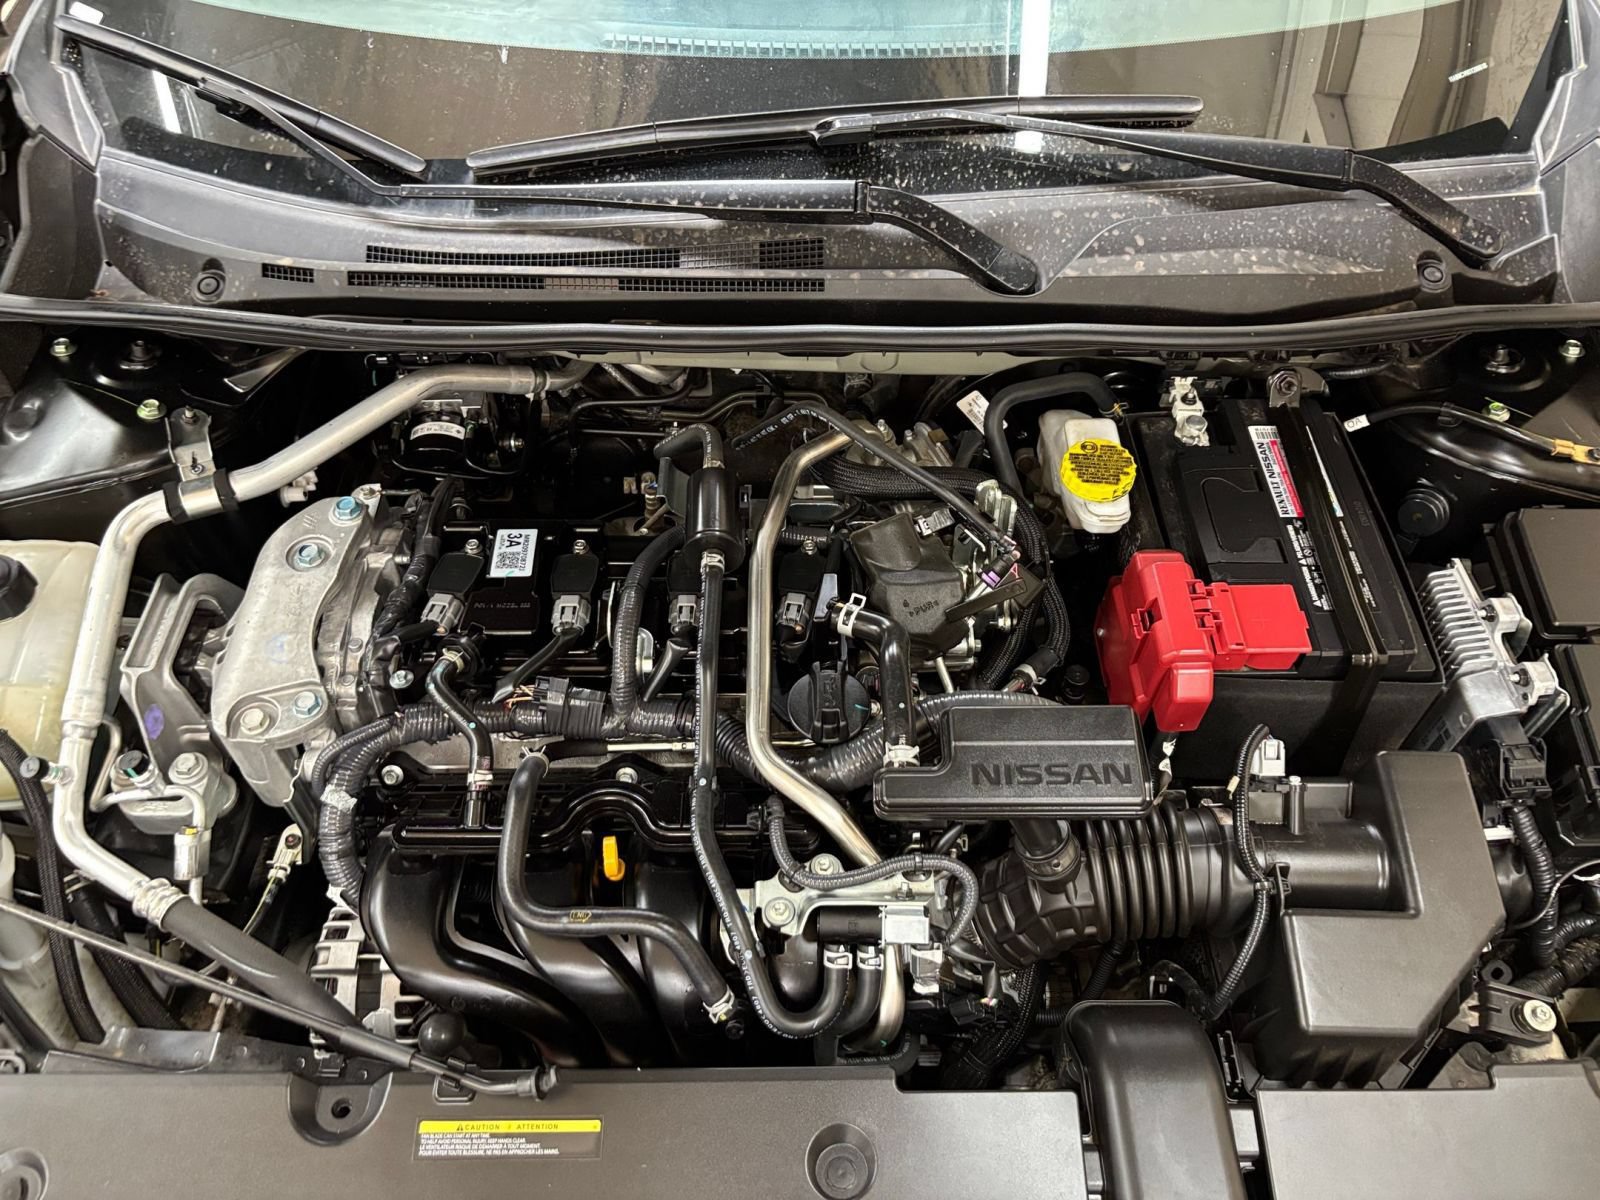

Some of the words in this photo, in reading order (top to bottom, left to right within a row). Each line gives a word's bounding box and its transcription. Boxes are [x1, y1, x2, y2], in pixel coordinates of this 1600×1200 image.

[1256, 442, 1277, 479] NISSAN
[1271, 480, 1291, 515] RENAULT
[506, 533, 523, 548] 3A
[971, 762, 1133, 786] NISSAN
[464, 1123, 500, 1131] CAUTION
